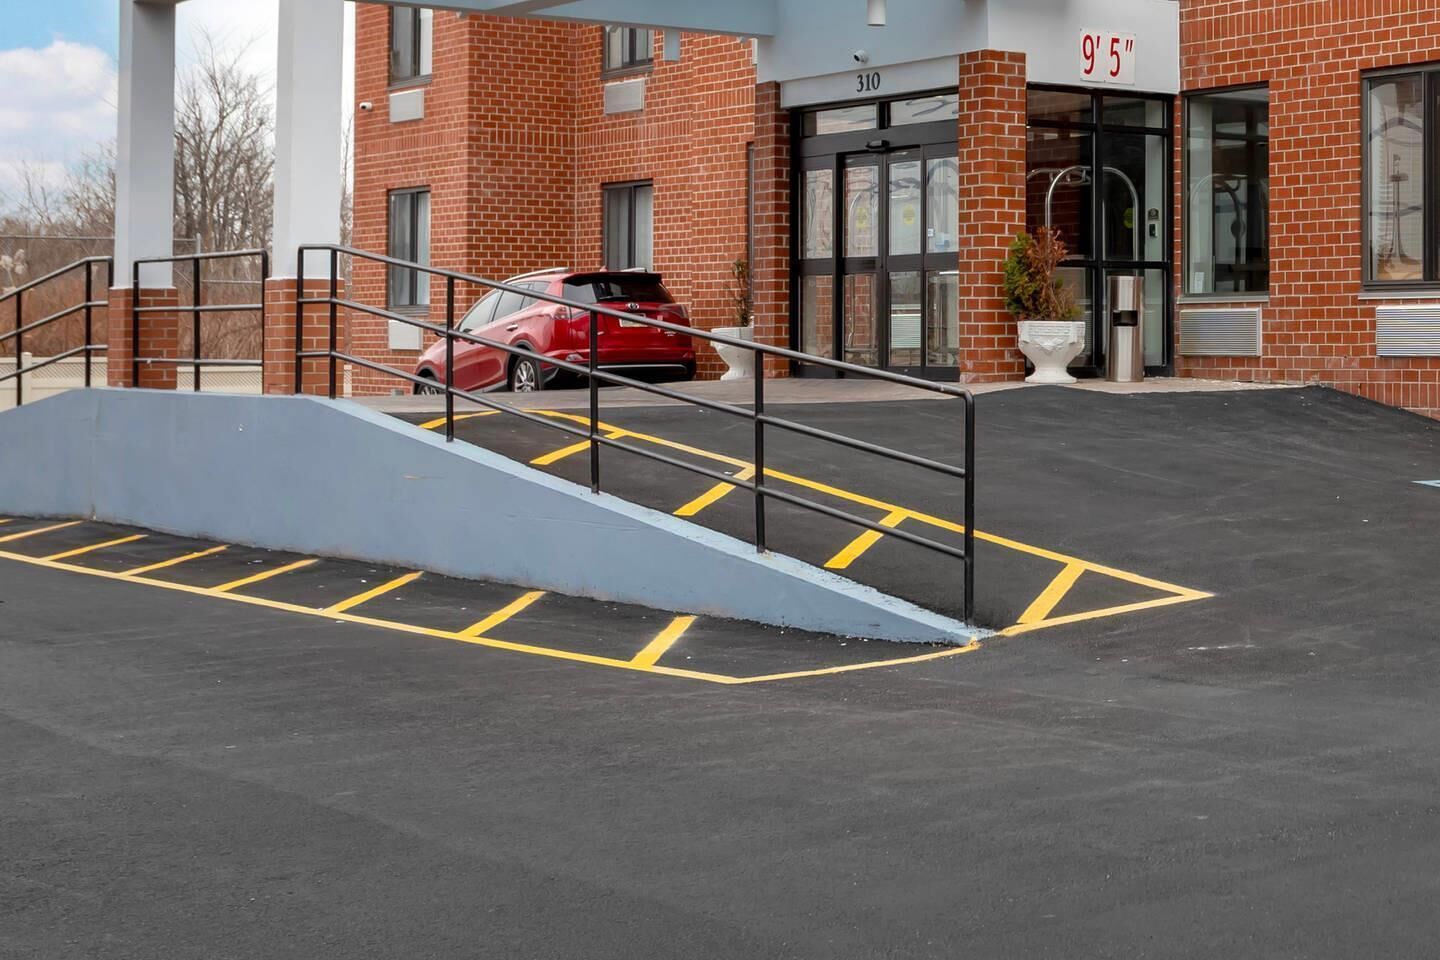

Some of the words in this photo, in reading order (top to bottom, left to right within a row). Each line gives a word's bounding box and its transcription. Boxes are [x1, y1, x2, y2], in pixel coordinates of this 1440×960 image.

[1082, 34, 1101, 75] 9'
[1109, 37, 1134, 77] 5"
[856, 71, 881, 92] 310
